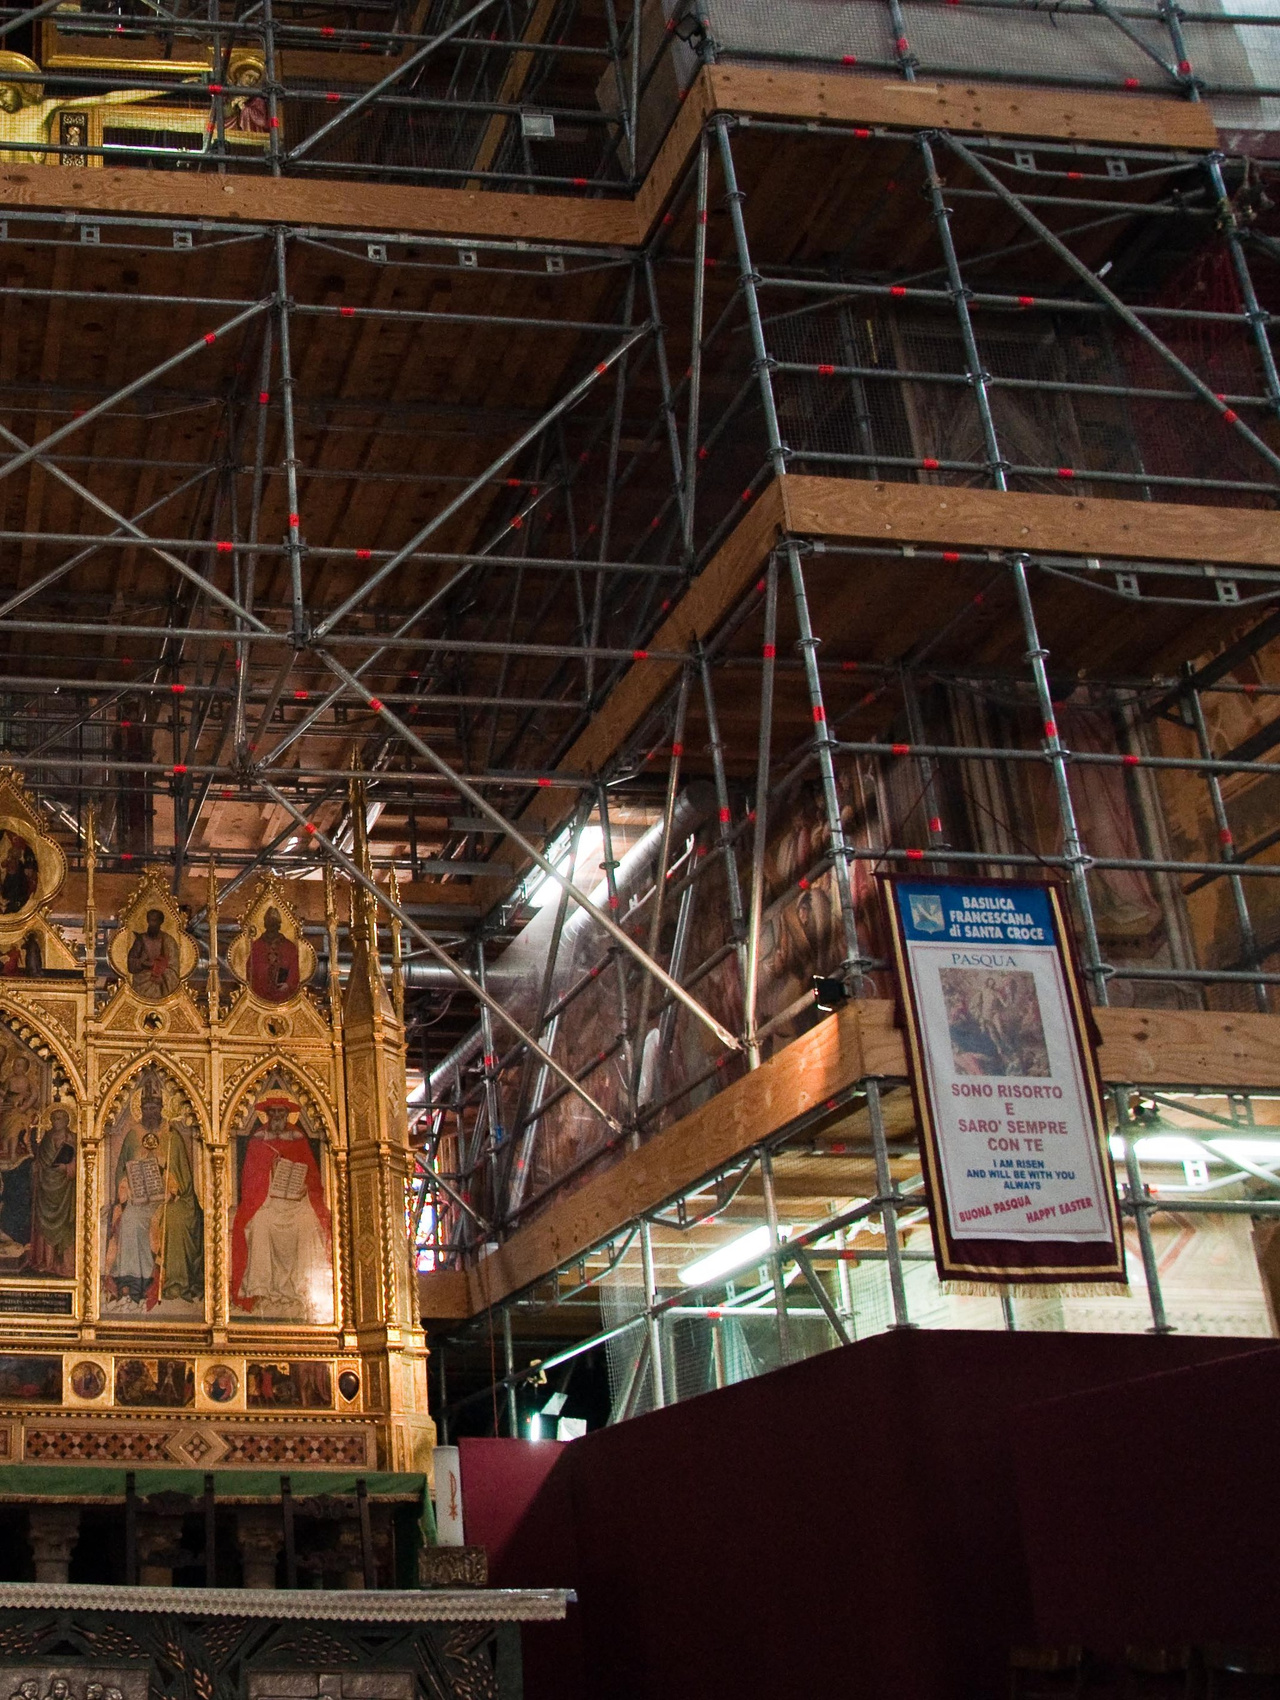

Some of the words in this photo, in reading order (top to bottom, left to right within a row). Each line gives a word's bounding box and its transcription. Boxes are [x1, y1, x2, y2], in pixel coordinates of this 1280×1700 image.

[962, 896, 1016, 911] BASILICA
[949, 910, 1034, 926] FRANCESCANA
[949, 923, 961, 937] di
[964, 925, 1004, 939] SANTA
[1006, 926, 1045, 940] CROCE
[951, 953, 1017, 968] PASQUA
[951, 1083, 993, 1097] SONO
[997, 1084, 1063, 1099] RISORTO
[1004, 1102, 1015, 1116] E
[958, 1119, 1002, 1133] SARO'
[1007, 1120, 1068, 1135] SEMPRE
[987, 1137, 1020, 1152] CON
[1023, 1138, 1044, 1152] TE
[992, 1159, 997, 1168] I
[999, 1159, 1014, 1168] AM
[1016, 1159, 1045, 1169] RISEN
[966, 1169, 986, 1178] AND
[988, 1170, 1012, 1179] WILL
[1013, 1170, 1026, 1179] BE
[1028, 1170, 1053, 1180] WITH
[1055, 1170, 1075, 1180] YOU
[1003, 1181, 1042, 1190] ALWAYS
[959, 1205, 992, 1223] BUONA
[993, 1195, 1032, 1214] PASQUA
[1025, 1206, 1057, 1223] HAPPY
[1058, 1197, 1094, 1215] EASTER
